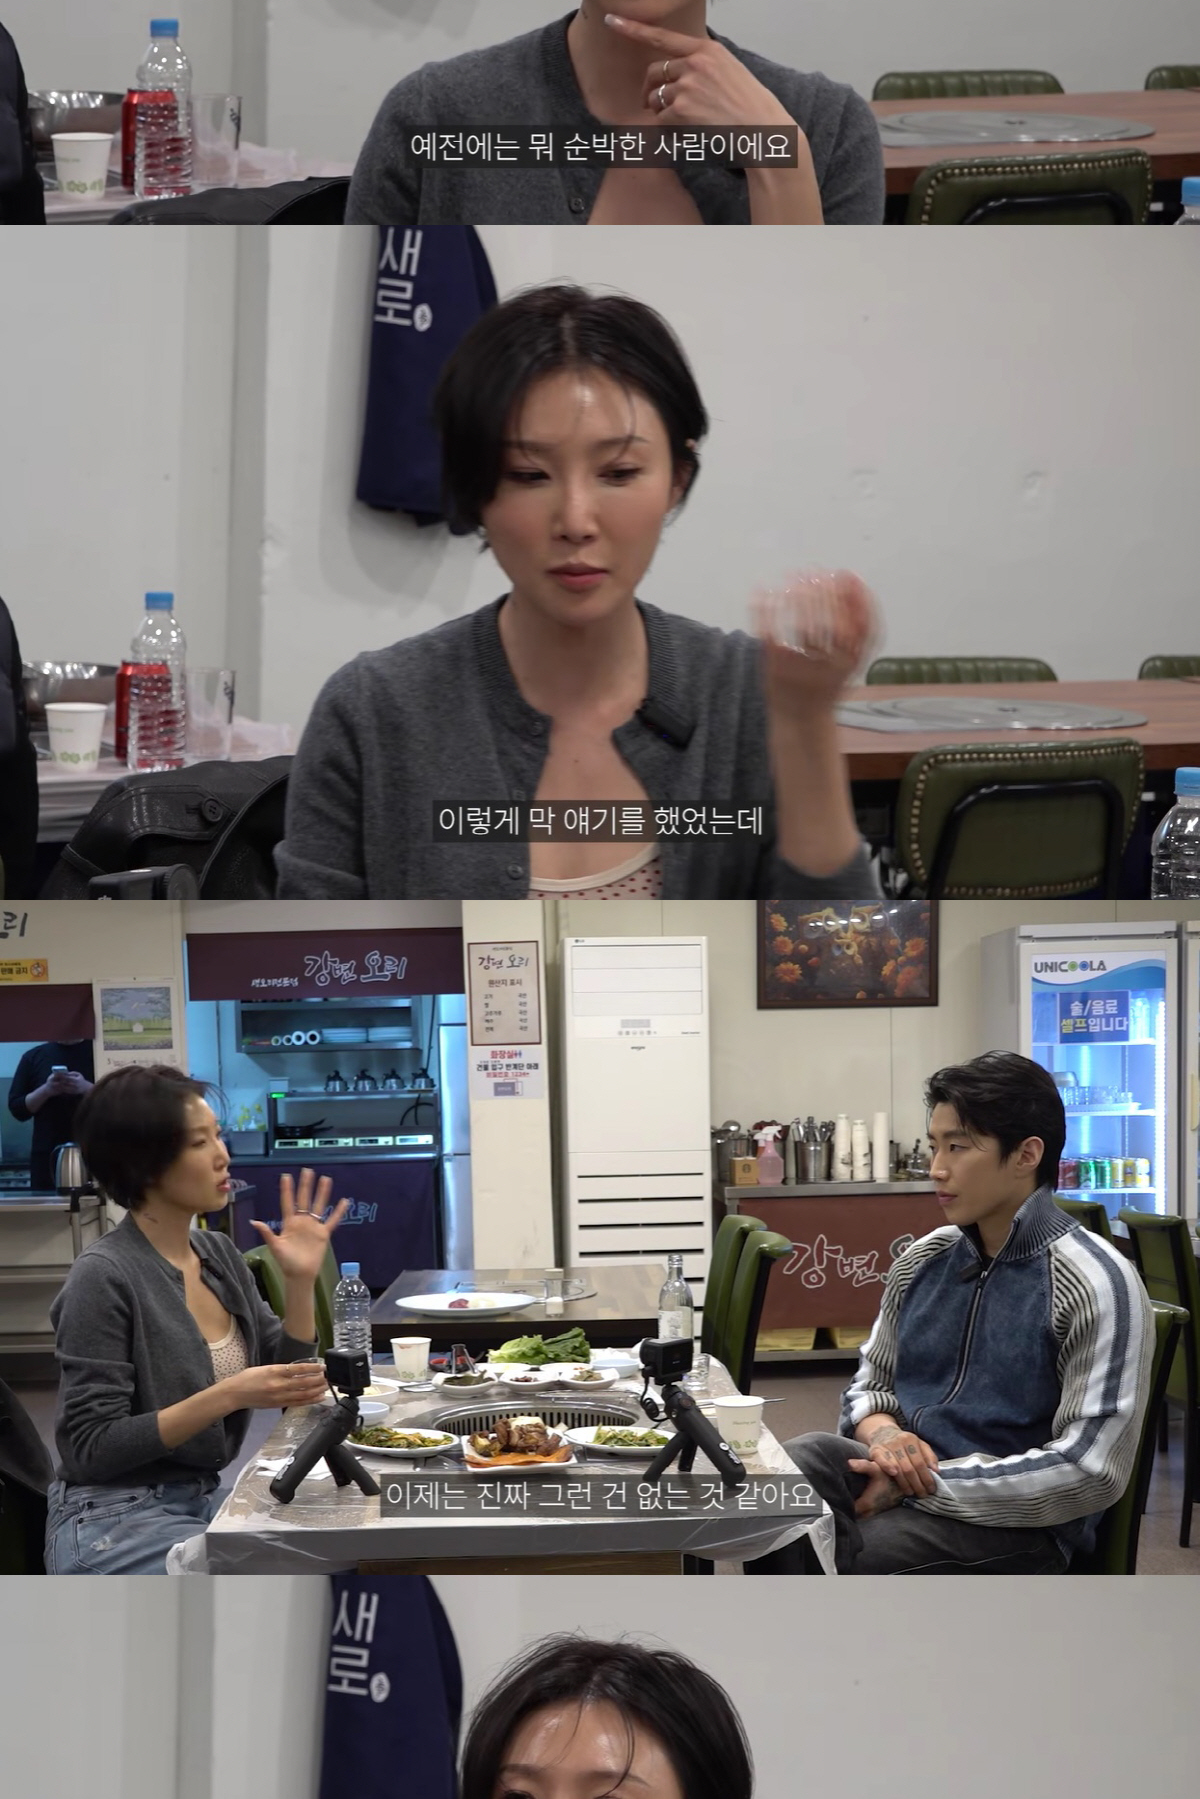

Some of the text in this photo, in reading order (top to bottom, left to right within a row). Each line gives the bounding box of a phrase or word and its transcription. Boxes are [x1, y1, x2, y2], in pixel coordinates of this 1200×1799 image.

[360, 950, 408, 983] 오리
[1034, 960, 1107, 973] UNICOOLA
[1070, 999, 1118, 1017] 술/음료
[1061, 1016, 1129, 1034] 셀프입니다
